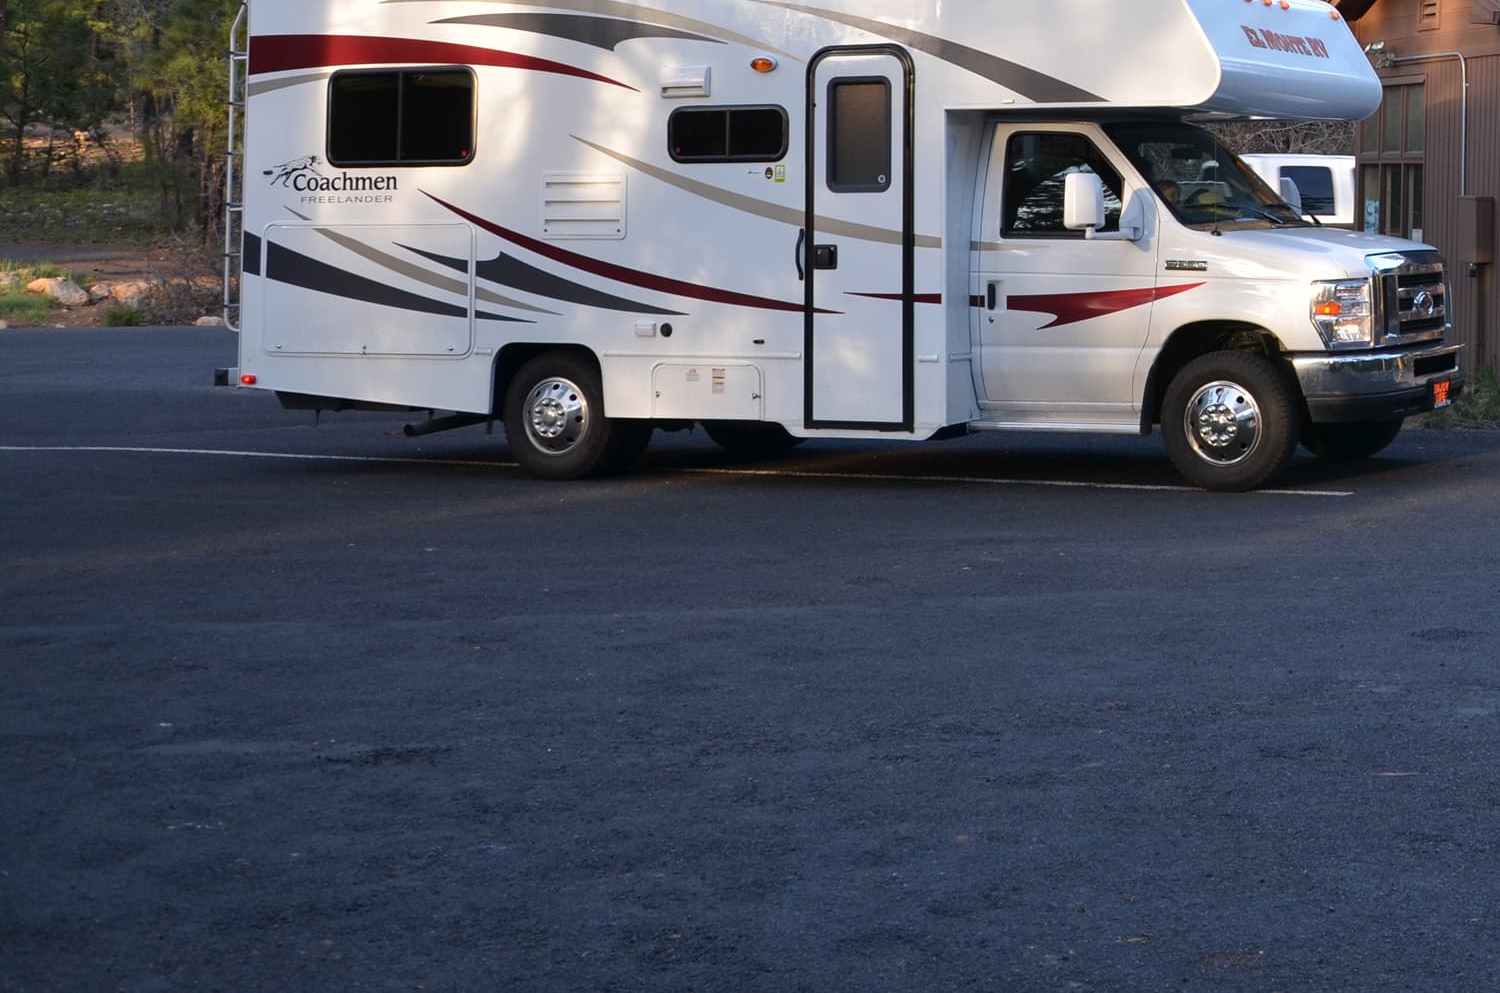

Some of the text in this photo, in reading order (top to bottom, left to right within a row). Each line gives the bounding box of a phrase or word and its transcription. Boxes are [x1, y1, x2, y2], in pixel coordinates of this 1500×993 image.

[1259, 28, 1312, 56] MONTE
[1304, 36, 1329, 59] RV
[293, 171, 397, 191] Coachmen
[301, 195, 393, 204] FREELANDER
